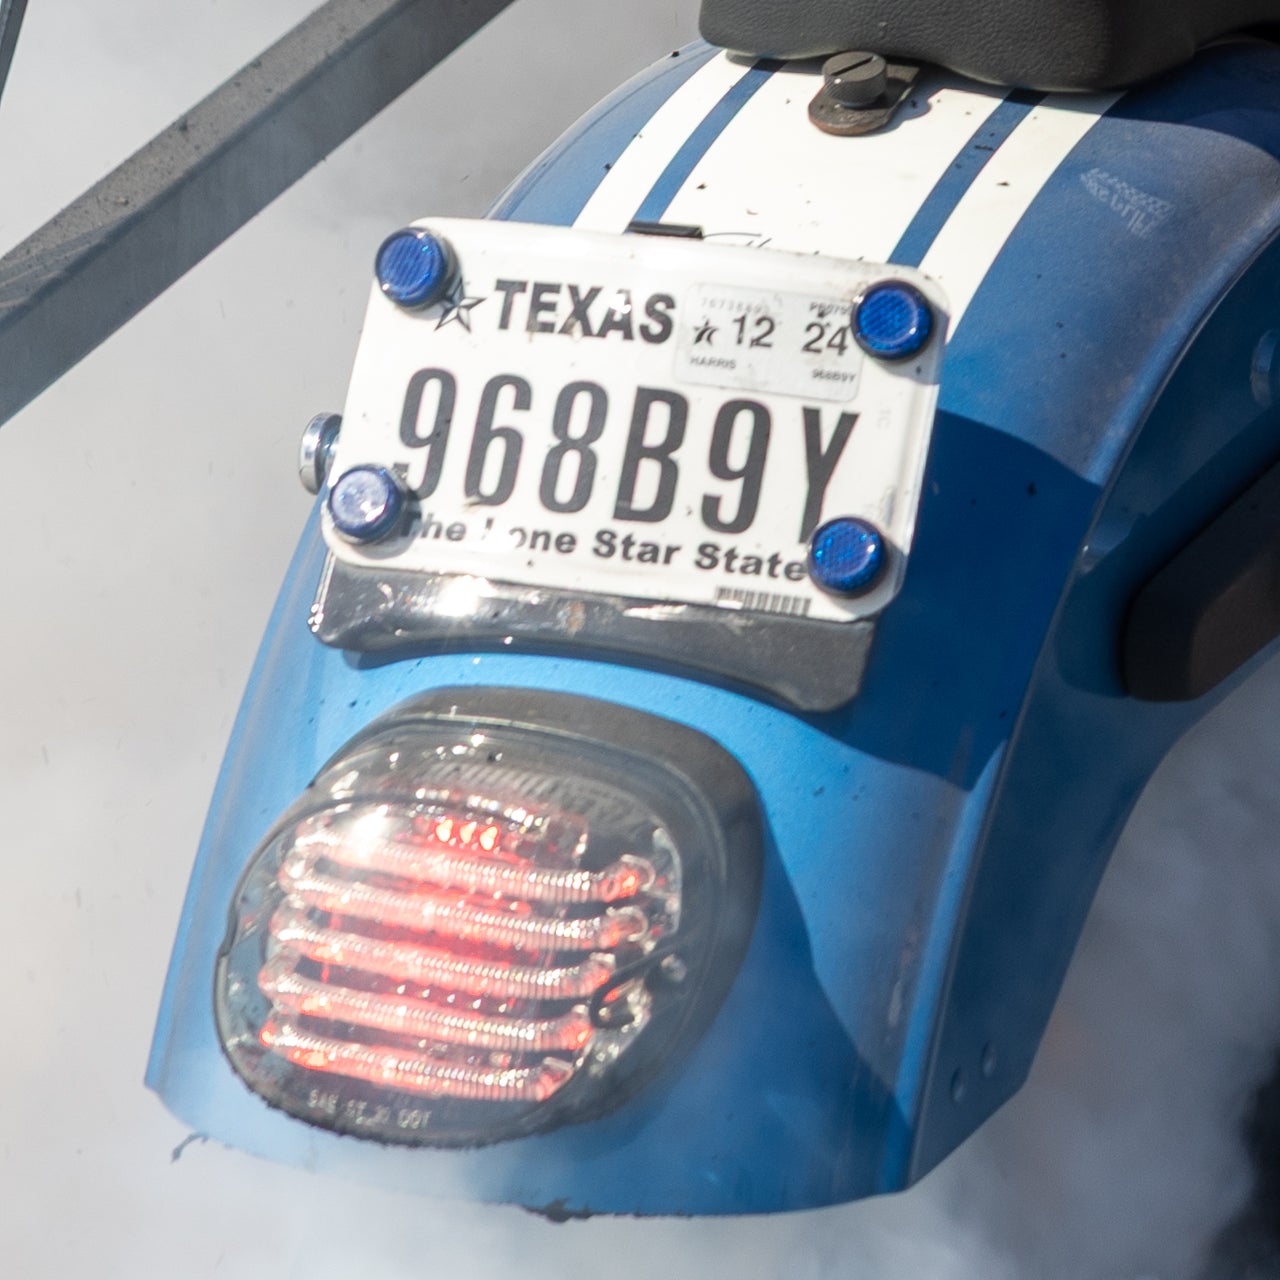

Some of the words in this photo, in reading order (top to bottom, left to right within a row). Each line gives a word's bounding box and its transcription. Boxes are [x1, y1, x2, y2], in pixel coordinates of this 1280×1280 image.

[495, 278, 676, 345] TEXAS
[732, 312, 776, 348] 12
[802, 321, 850, 356] 24
[391, 366, 860, 544] 968B9Y
[593, 528, 681, 566] Star
[694, 540, 808, 583] State
